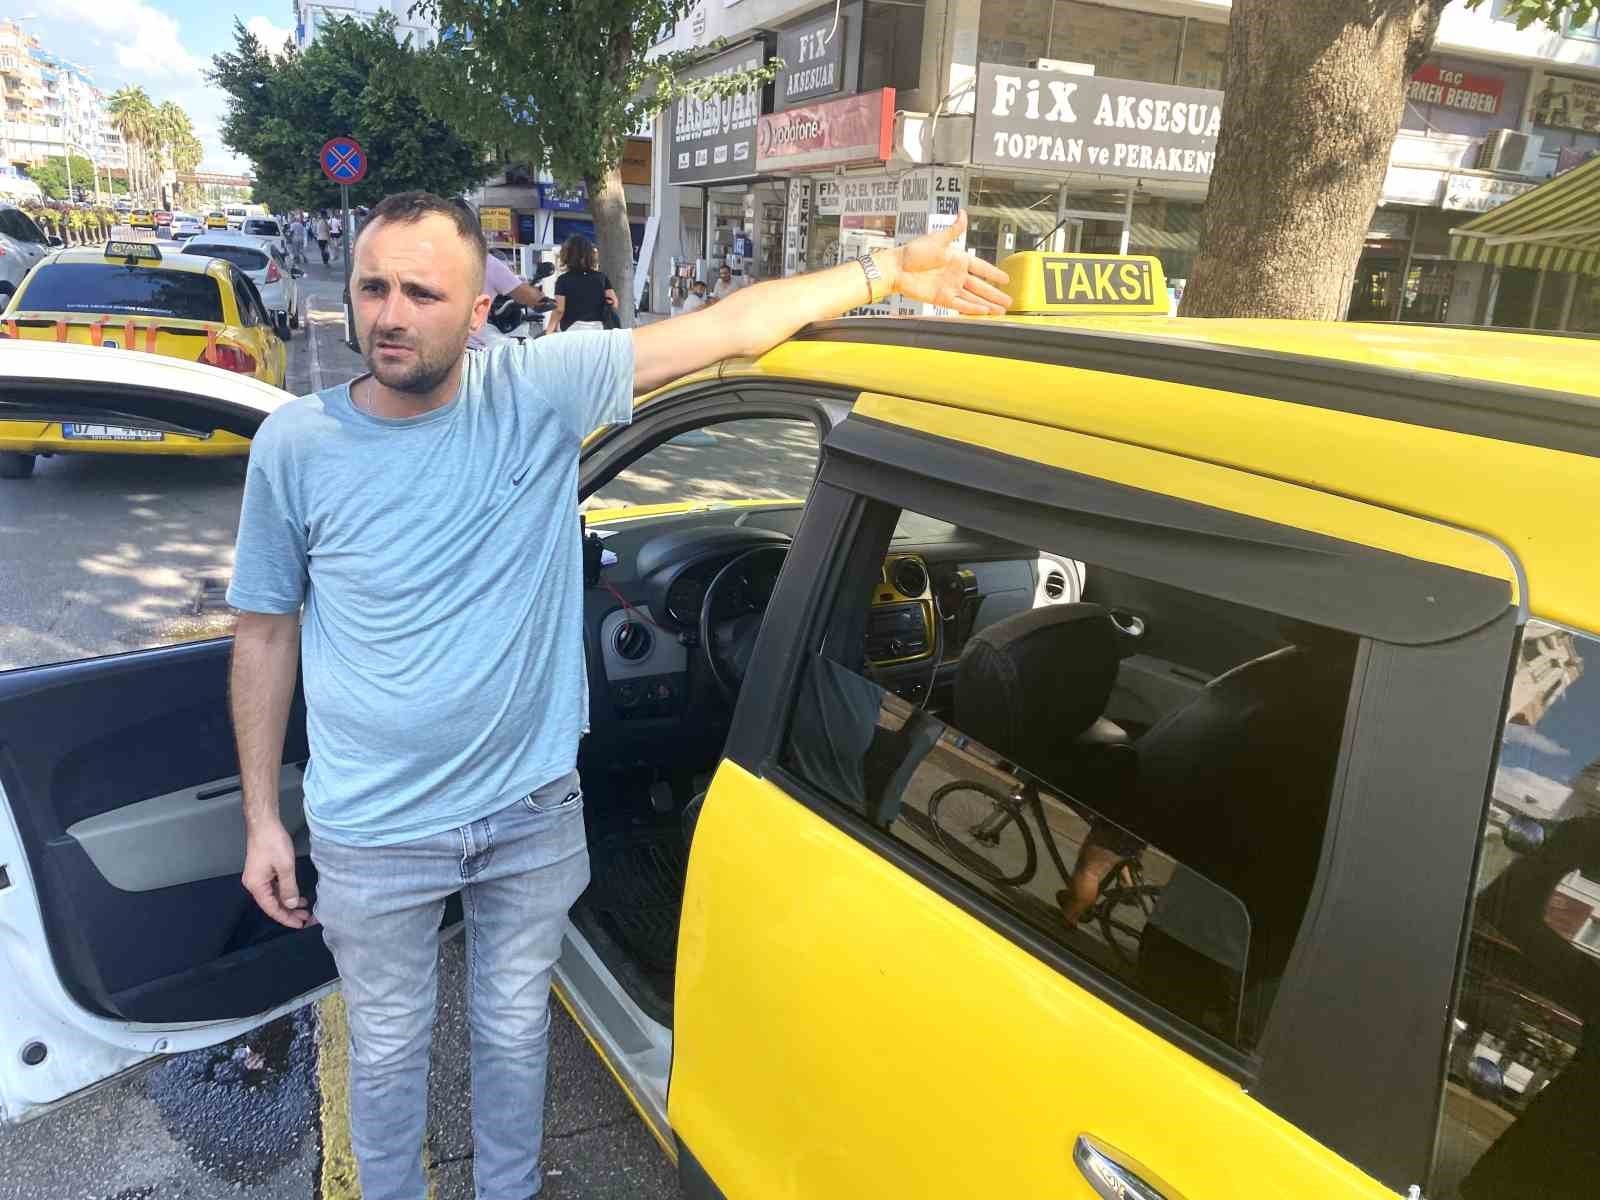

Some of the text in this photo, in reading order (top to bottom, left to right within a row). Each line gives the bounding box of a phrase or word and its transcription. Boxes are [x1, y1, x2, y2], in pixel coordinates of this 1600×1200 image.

[798, 27, 827, 64] FiX
[786, 63, 834, 96] AKSESUAR
[991, 74, 1078, 124] FiX
[771, 118, 818, 146] vodafone
[993, 131, 1084, 163] TOPTAN
[1088, 145, 1110, 166] ve
[935, 176, 961, 193] 2. EL
[1045, 261, 1153, 301] TAKSi
